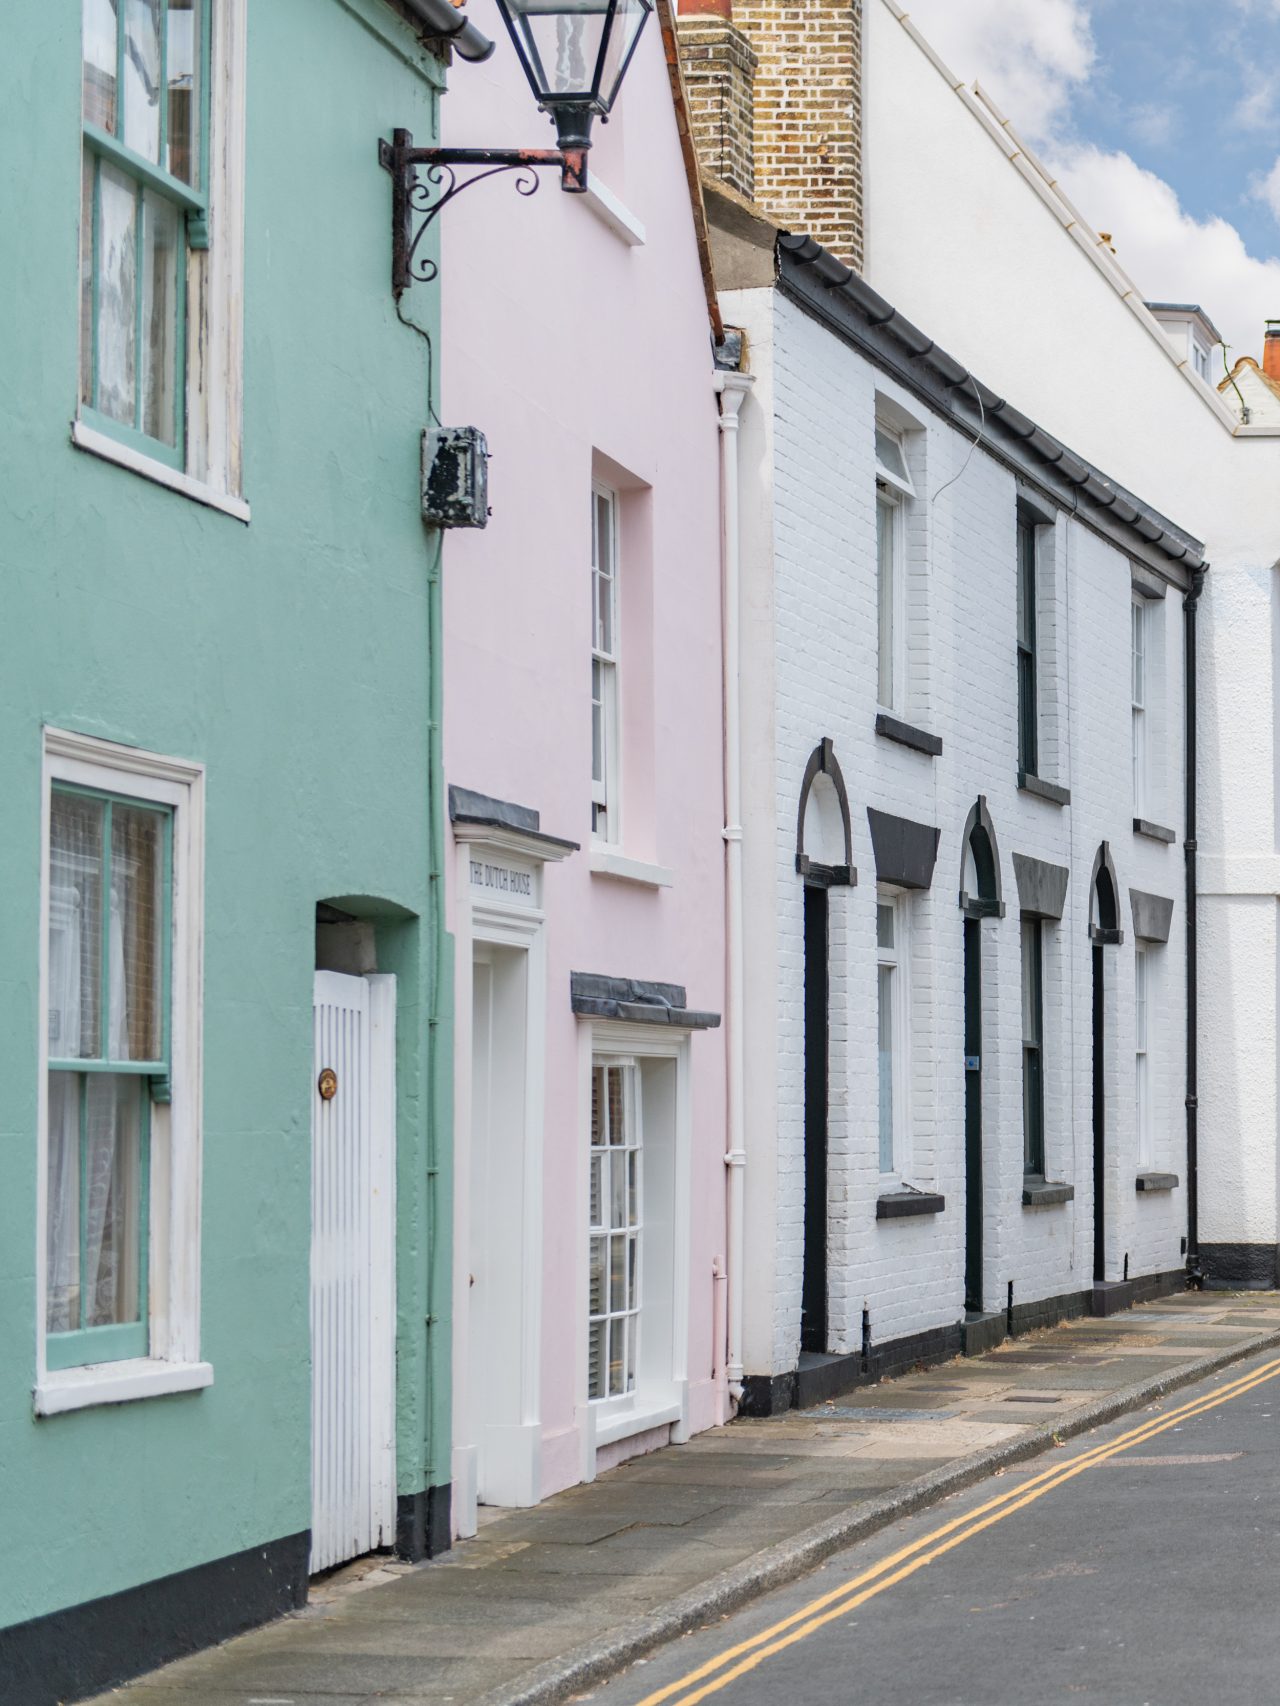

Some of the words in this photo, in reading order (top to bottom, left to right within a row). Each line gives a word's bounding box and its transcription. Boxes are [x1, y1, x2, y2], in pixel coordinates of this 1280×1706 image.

[469, 861, 482, 885] THE
[485, 865, 508, 891] DUTCH
[510, 870, 530, 895] HOUSE
